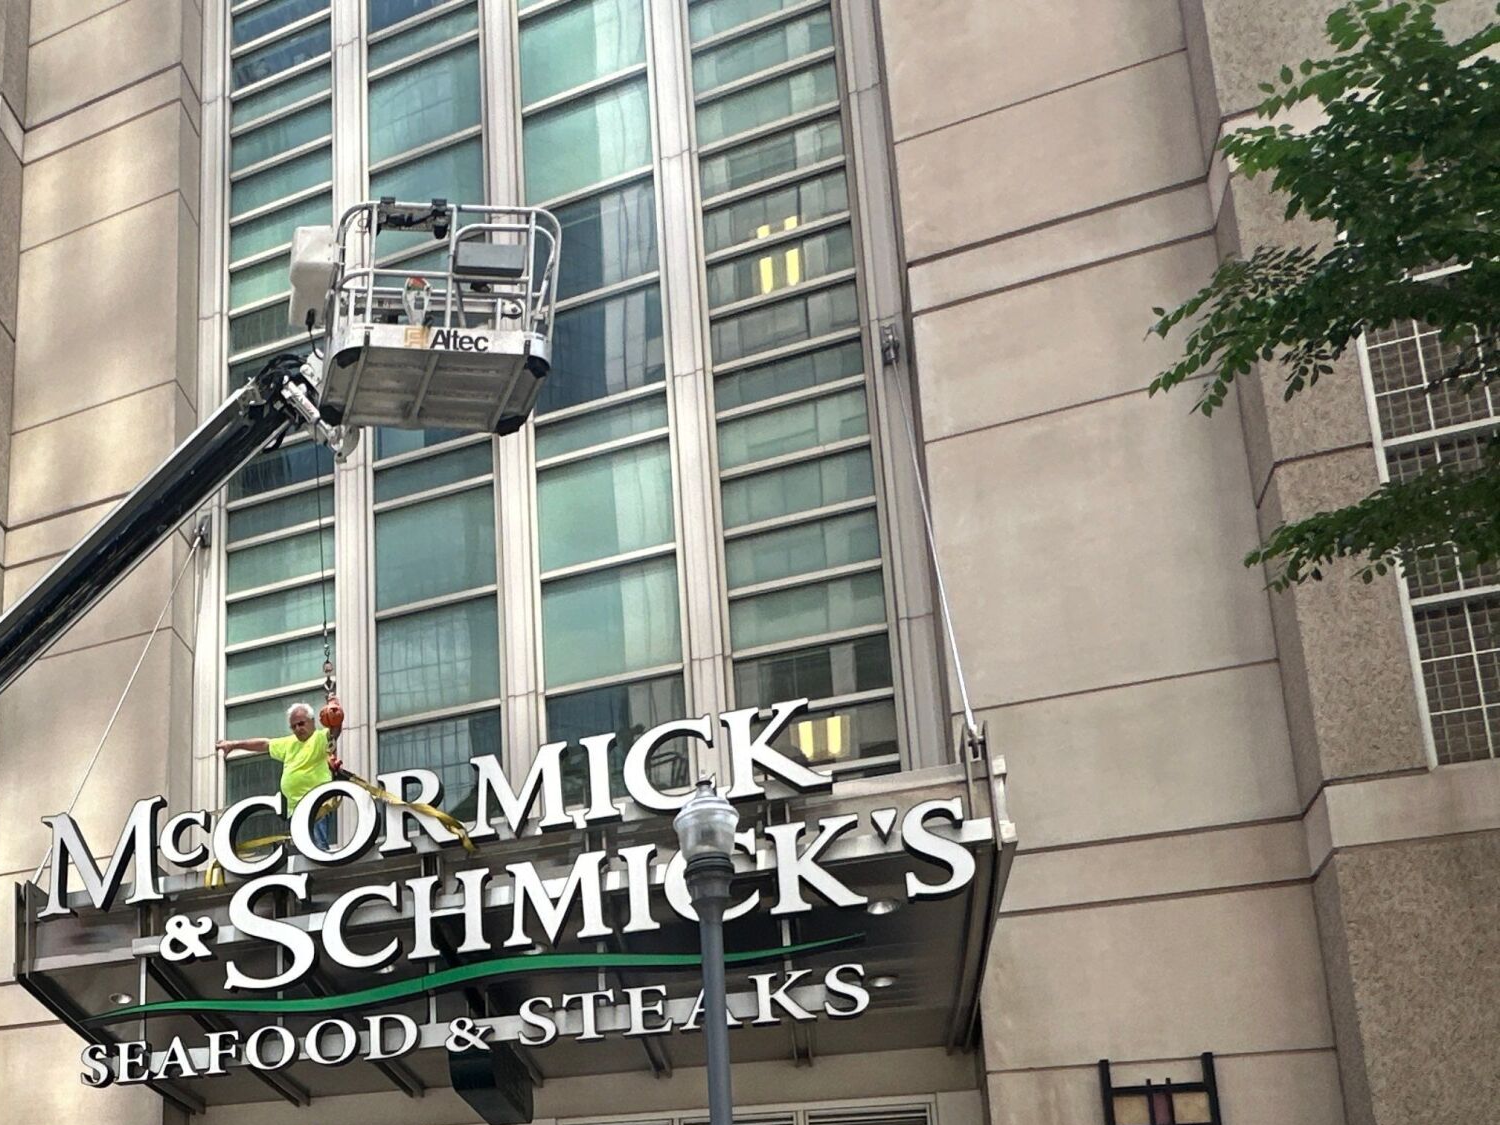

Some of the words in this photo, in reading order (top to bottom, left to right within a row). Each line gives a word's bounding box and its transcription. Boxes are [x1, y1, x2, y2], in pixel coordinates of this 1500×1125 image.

[430, 329, 489, 352] Altec
[159, 914, 212, 961] &
[80, 1013, 419, 1086] SEAFOOD
[445, 1017, 494, 1052] &
